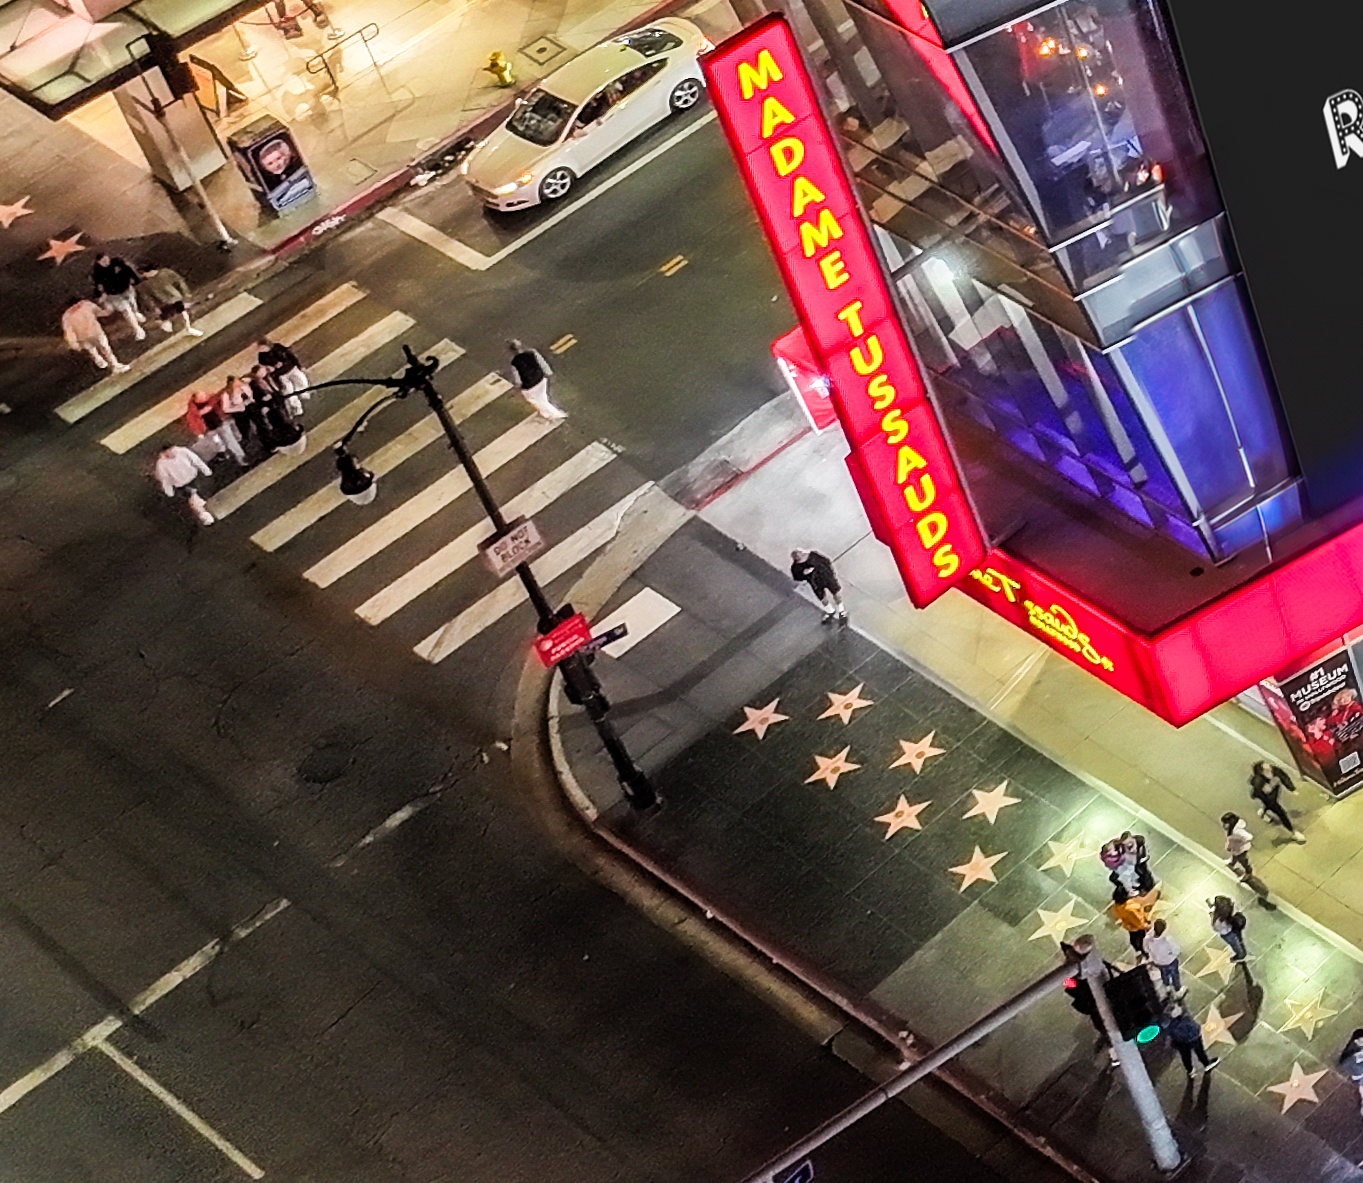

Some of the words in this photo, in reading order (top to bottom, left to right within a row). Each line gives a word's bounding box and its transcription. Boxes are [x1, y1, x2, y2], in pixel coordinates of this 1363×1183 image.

[738, 49, 849, 290] MADAME
[838, 300, 960, 578] TUSSAUDS
[510, 524, 529, 543] NOT
[1289, 663, 1349, 703] MUSEUM
